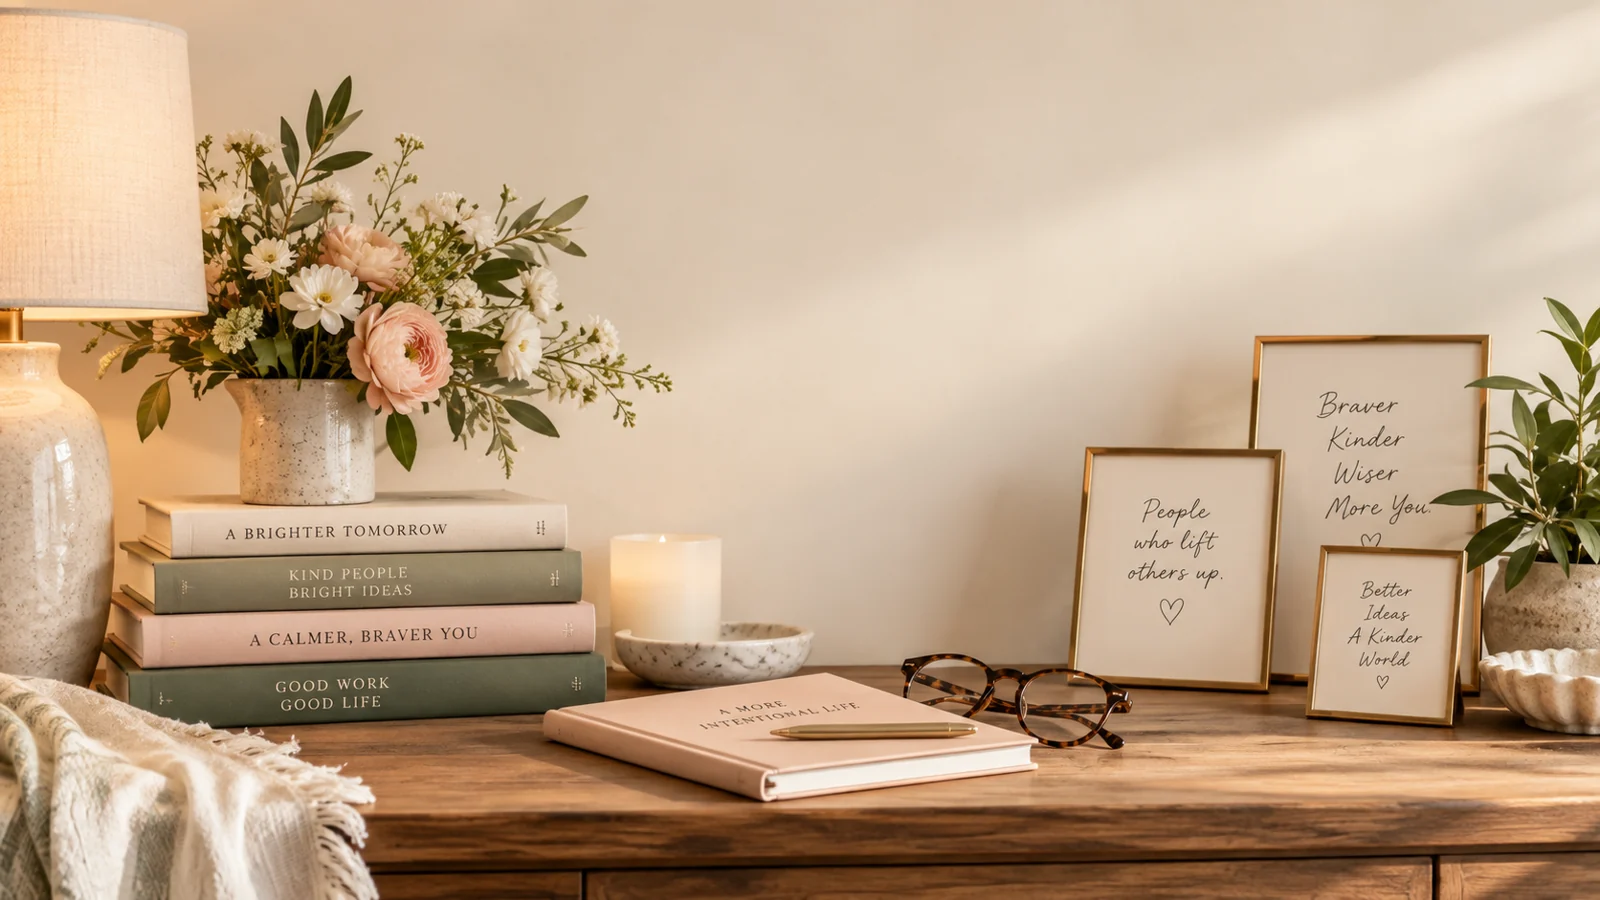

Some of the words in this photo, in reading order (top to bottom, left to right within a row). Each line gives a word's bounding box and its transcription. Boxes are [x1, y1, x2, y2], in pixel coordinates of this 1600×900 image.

[1317, 391, 1398, 418] Braver
[1328, 426, 1405, 452] Kinder
[1334, 460, 1398, 484] Wiser
[1142, 498, 1210, 528] People
[1325, 495, 1382, 520] More
[1389, 494, 1431, 525] You.
[225, 528, 236, 541] A
[244, 525, 336, 540] BRIGHTER
[342, 523, 448, 538] TOMORROW
[1134, 530, 1173, 549] who
[1181, 530, 1218, 558] lift
[289, 568, 334, 581] KIND
[342, 566, 408, 580] PEOPLE
[1128, 561, 1189, 581] others
[1196, 568, 1223, 589] up.
[289, 585, 355, 598] BRIGHT
[362, 583, 412, 597] IDEAS
[1360, 581, 1412, 599] Better
[1364, 604, 1409, 621] Ideas
[249, 634, 262, 647] A
[268, 630, 353, 646] CALMER,
[361, 627, 433, 643] BRAVER
[440, 626, 478, 640] YOU
[1347, 627, 1361, 644] A
[1368, 627, 1422, 645] Kinder
[1359, 651, 1410, 666] World
[275, 679, 329, 693] GOOD
[336, 676, 390, 690] WORK
[280, 697, 334, 712] GOOD
[342, 695, 381, 709] LIFE
[735, 700, 787, 713] MORE
[699, 707, 819, 730] INTENTIONAL
[822, 702, 860, 713] LIFE
